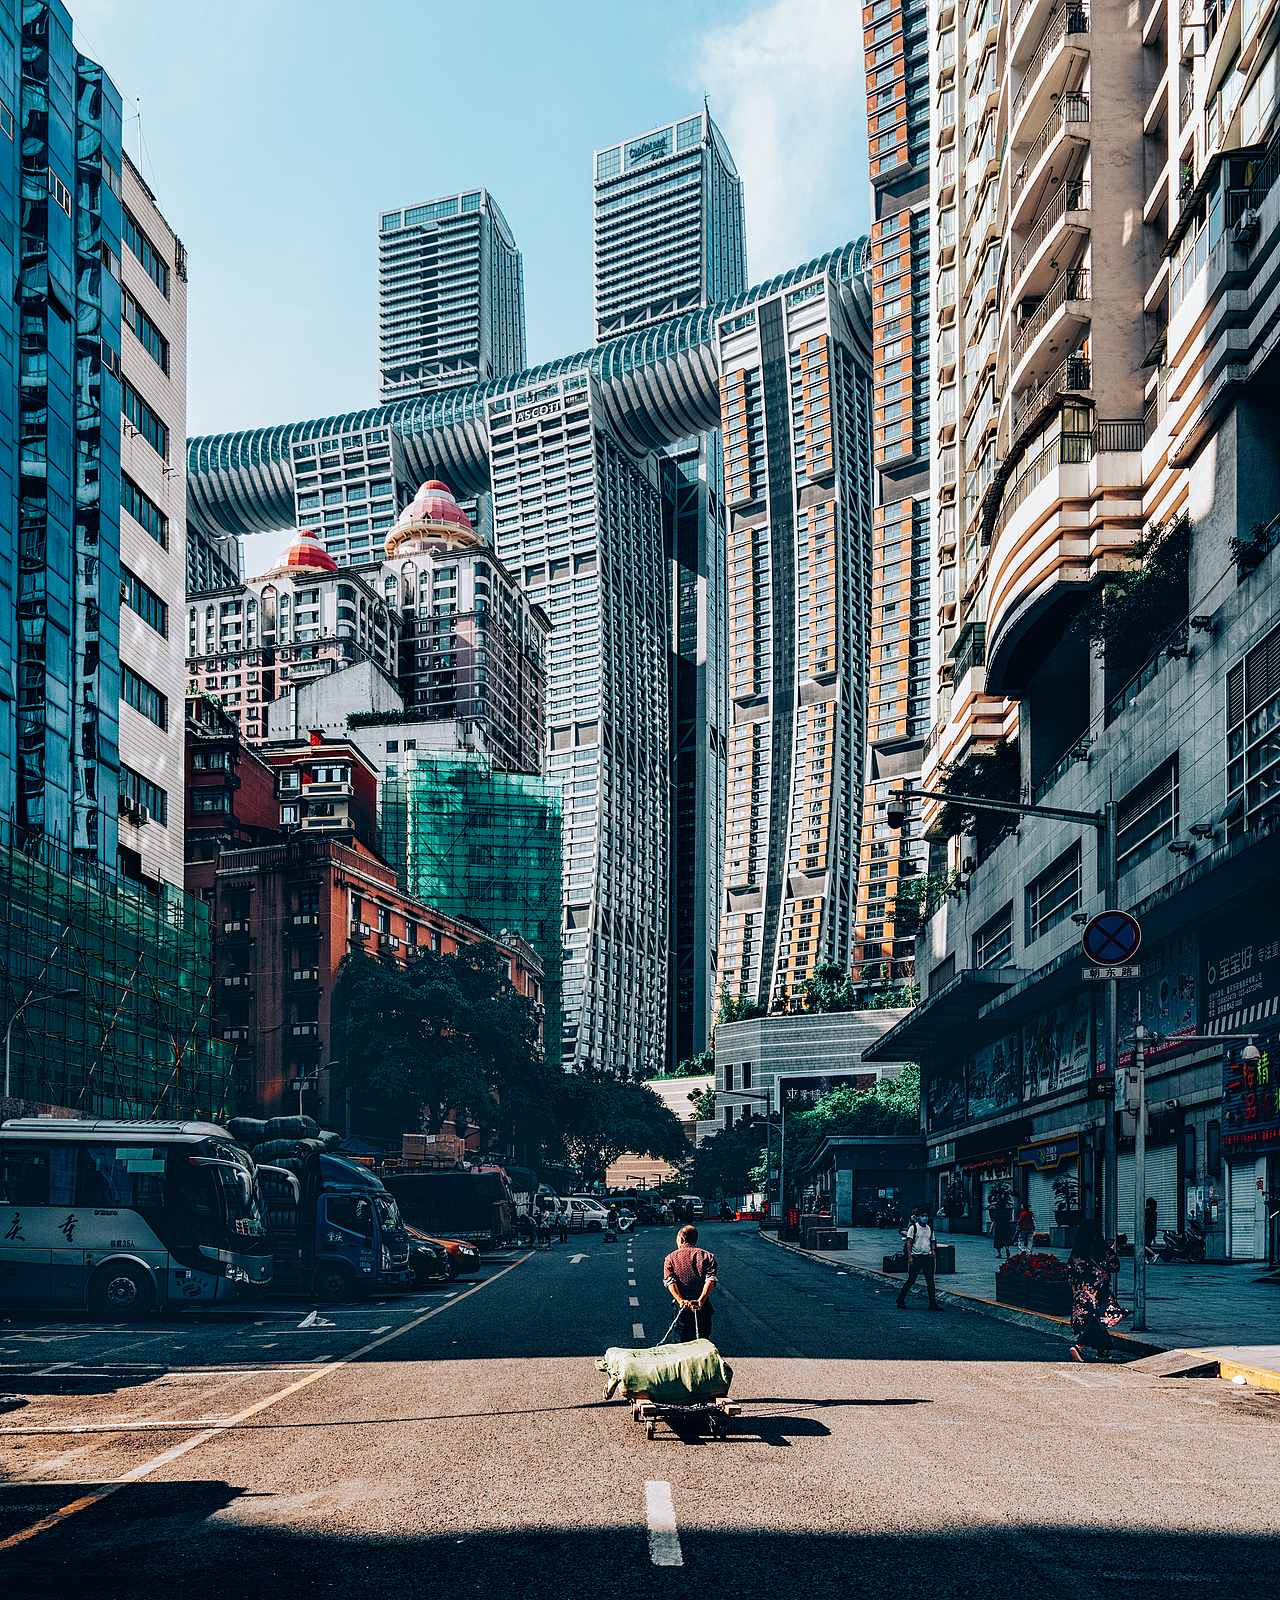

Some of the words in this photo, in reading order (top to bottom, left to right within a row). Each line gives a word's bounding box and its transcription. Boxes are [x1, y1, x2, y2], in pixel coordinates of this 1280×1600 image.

[1089, 967, 1133, 978] 朝东路
[1219, 944, 1253, 981] 宝宝好
